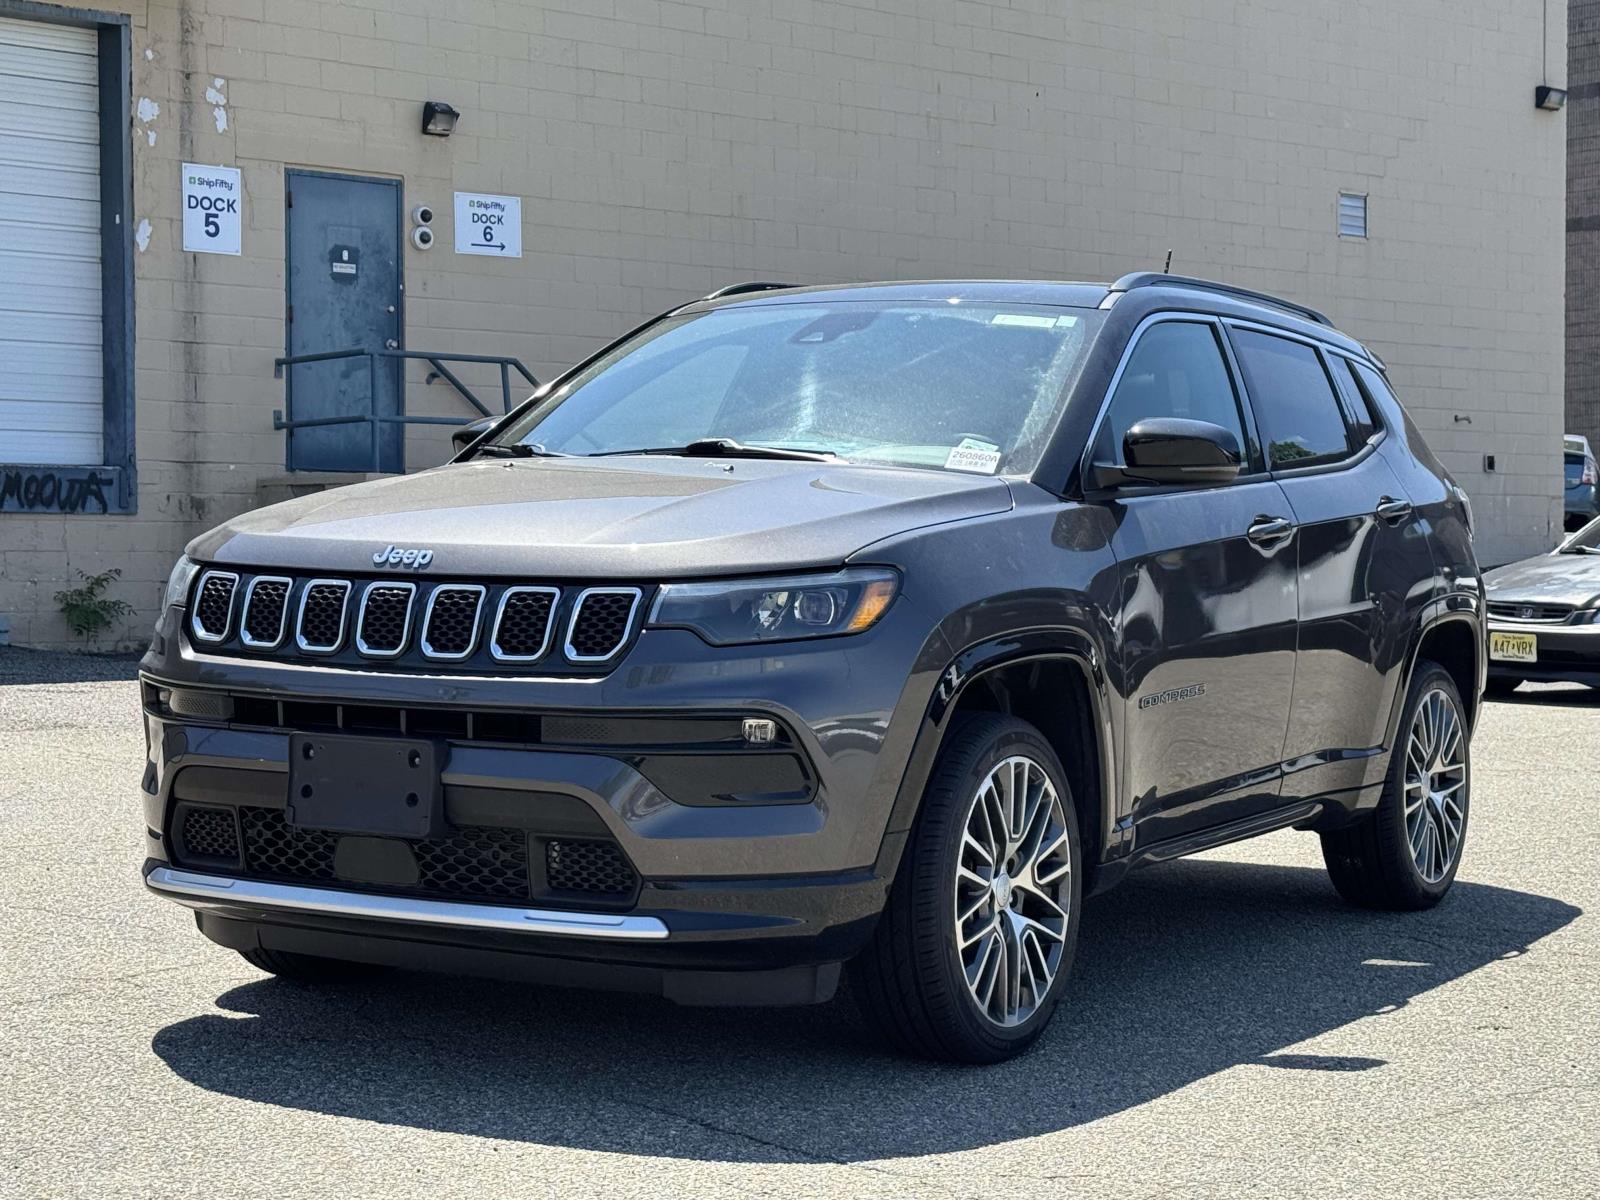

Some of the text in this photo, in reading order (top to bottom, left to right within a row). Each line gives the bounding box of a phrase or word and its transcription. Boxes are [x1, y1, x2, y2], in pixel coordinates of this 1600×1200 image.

[187, 194, 237, 214] DOCK
[204, 212, 220, 238] 5
[472, 213, 504, 226] DOCK
[483, 225, 493, 242] 6
[372, 544, 434, 569] Jeep
[1493, 639, 1511, 655] A47
[1140, 684, 1207, 709] COMPASS
